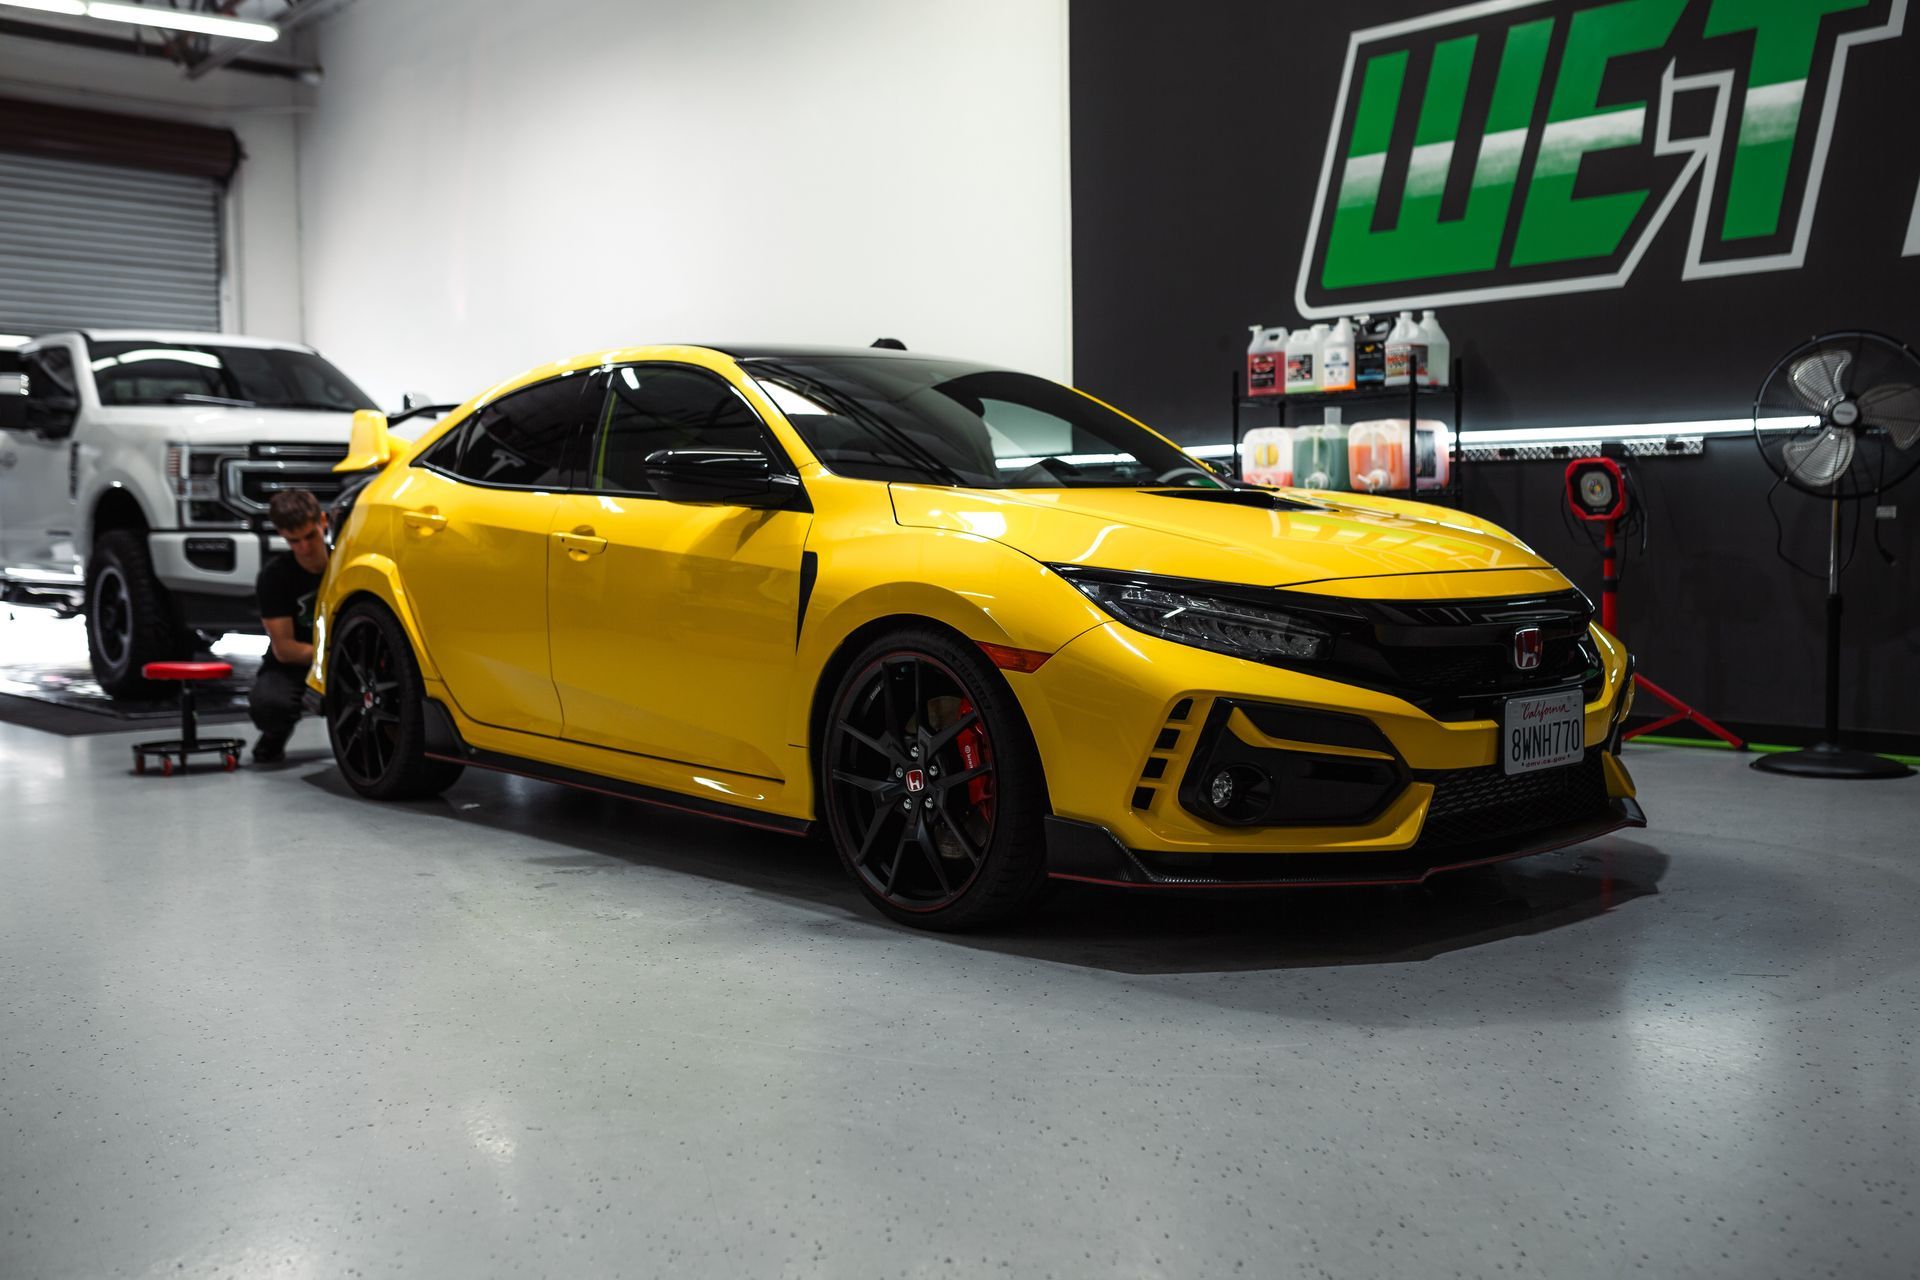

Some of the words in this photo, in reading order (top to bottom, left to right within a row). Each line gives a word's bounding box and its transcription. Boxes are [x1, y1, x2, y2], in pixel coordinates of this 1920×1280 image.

[1320, 0, 1872, 291] WET
[1522, 701, 1570, 722] California
[1512, 719, 1580, 762] 8WNH770
